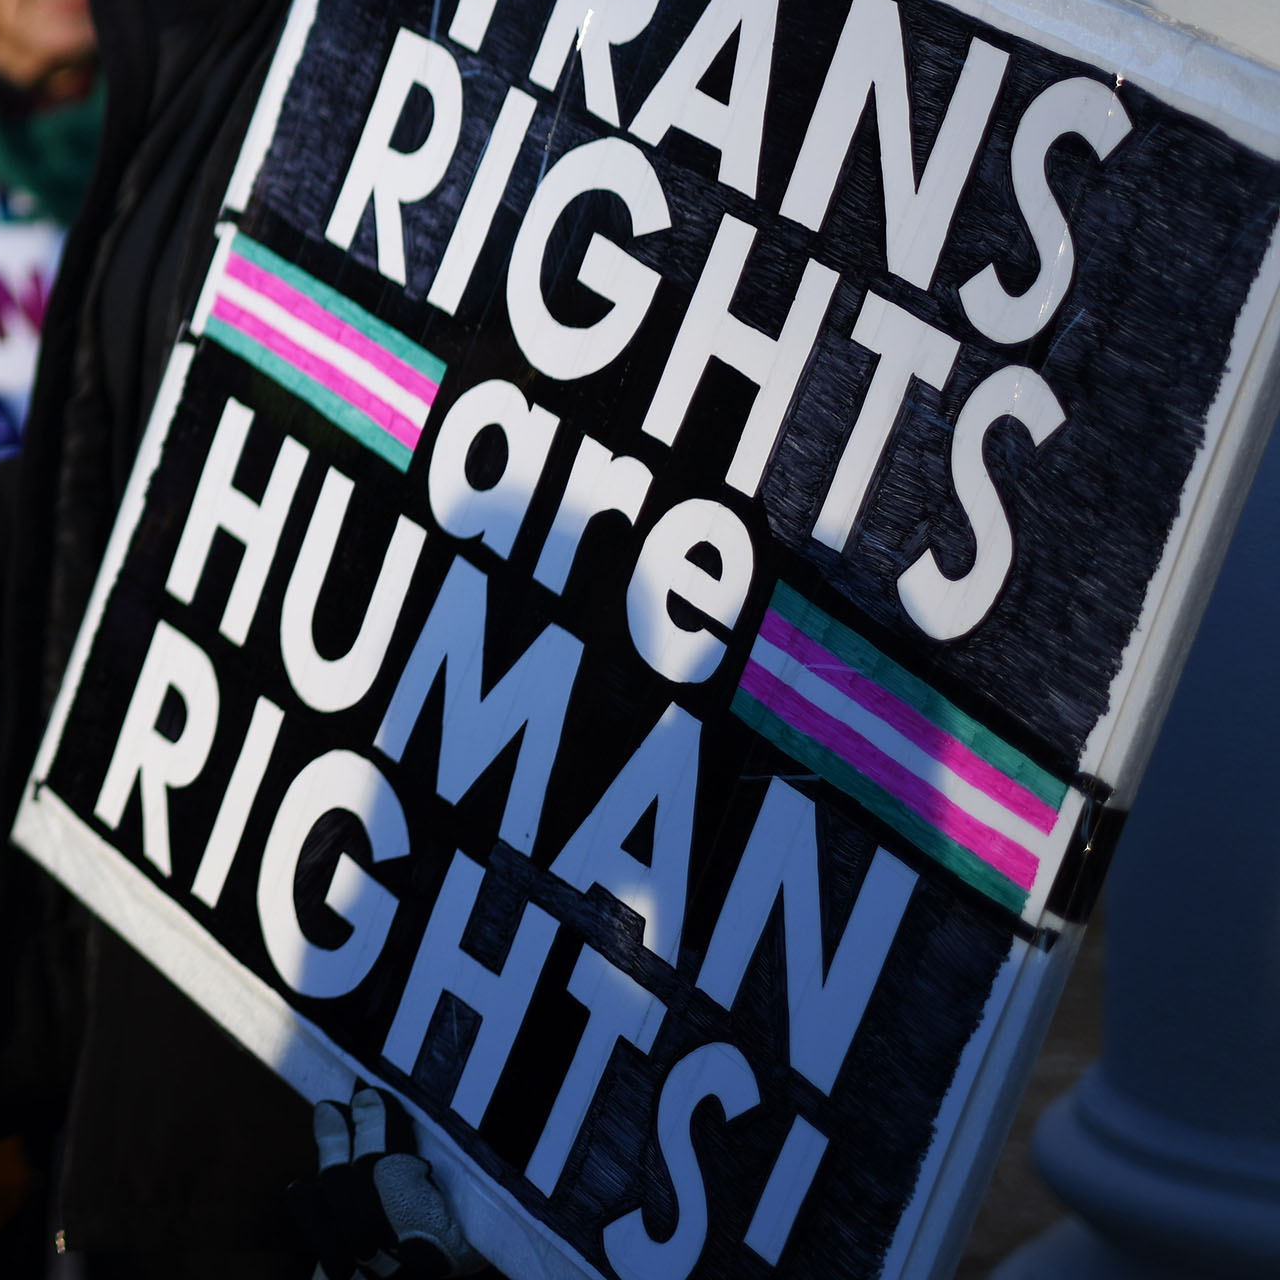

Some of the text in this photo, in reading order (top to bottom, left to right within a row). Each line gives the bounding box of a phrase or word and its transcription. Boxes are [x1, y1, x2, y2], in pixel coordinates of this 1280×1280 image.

[325, 27, 1068, 642] RIGHTS
[427, 378, 757, 685] are
[164, 395, 918, 1097] HUMAN
